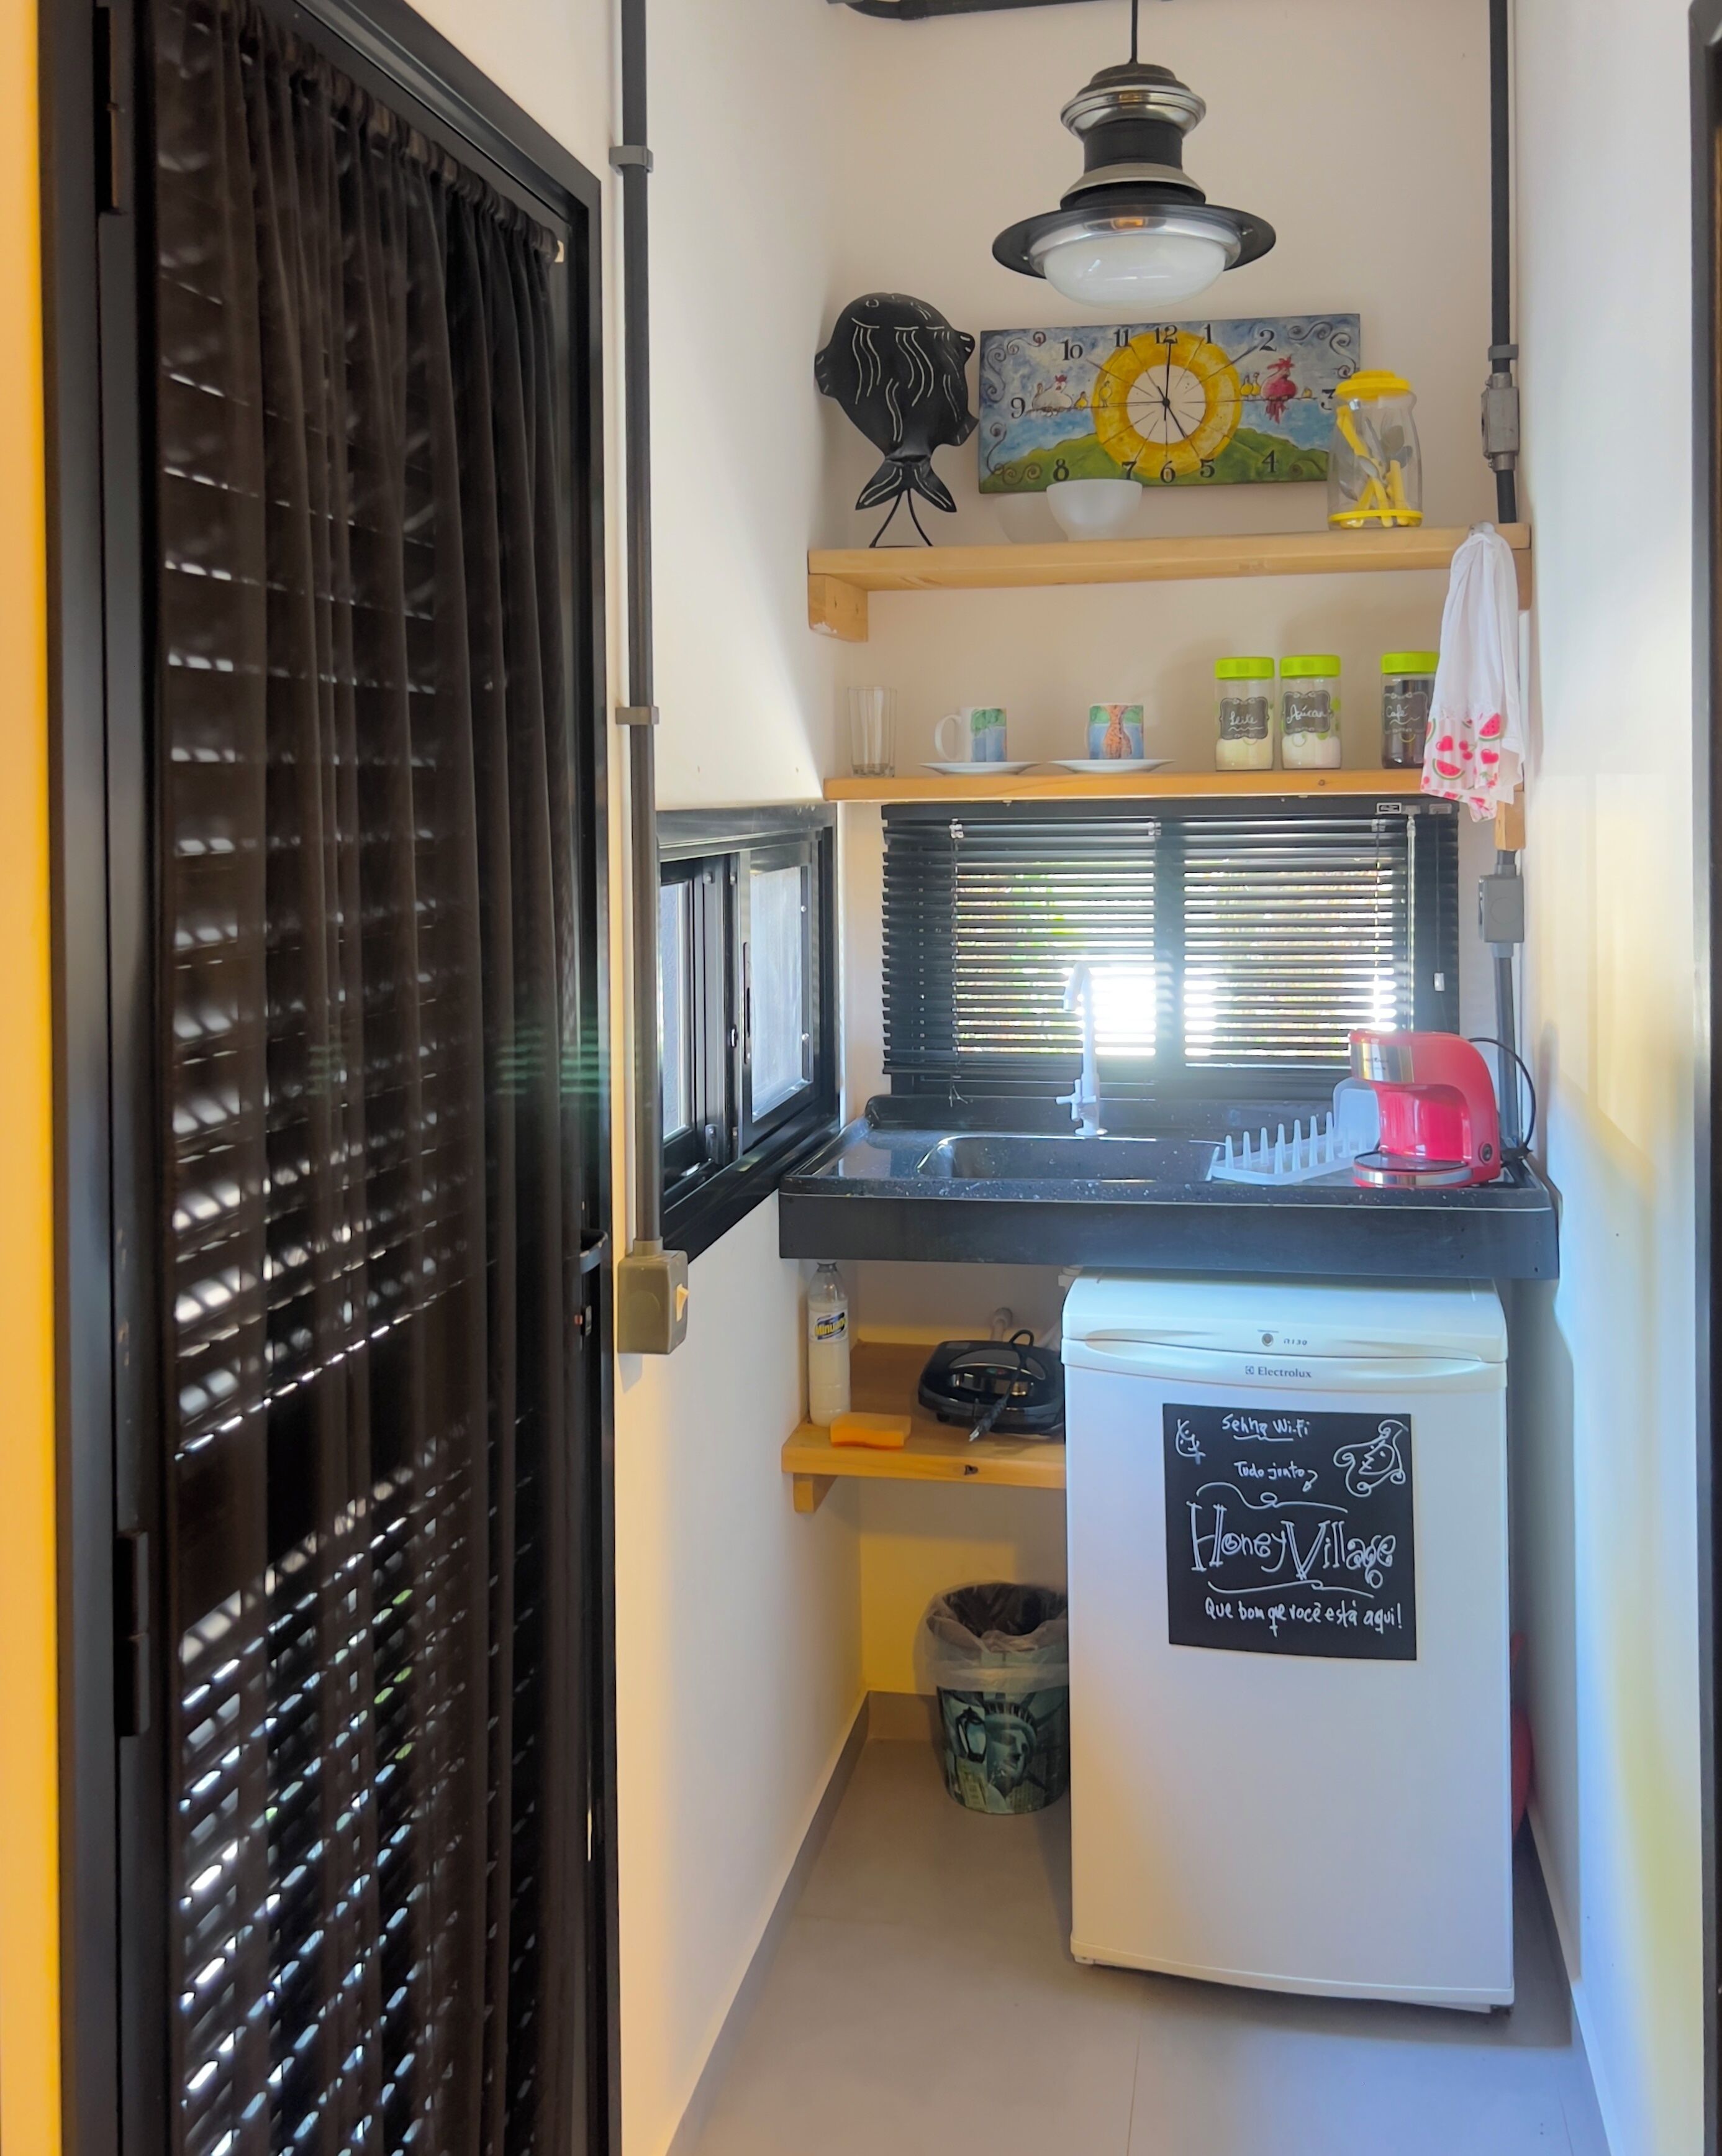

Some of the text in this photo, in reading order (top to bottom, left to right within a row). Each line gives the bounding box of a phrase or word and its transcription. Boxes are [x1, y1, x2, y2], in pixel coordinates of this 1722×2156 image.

[1113, 329, 1130, 348] 11
[1154, 325, 1179, 345] 12
[1202, 324, 1212, 344] 1
[1259, 329, 1277, 352] 2
[1061, 338, 1083, 361] 10
[1010, 397, 1026, 419] 9
[1053, 458, 1069, 482] 8
[1122, 461, 1137, 480] 7
[1160, 460, 1176, 483] 6
[1200, 458, 1217, 478] 5
[1261, 450, 1279, 474] 4
[1230, 711, 1258, 725] Leite
[1385, 704, 1408, 718] Café
[1258, 1366, 1312, 1378] Electrolux
[1221, 1413, 1268, 1437] Senha
[1233, 1460, 1305, 1480] Tudo junto
[1205, 1597, 1233, 1620] Que
[1238, 1601, 1265, 1621] bom
[1289, 1601, 1321, 1623] você
[1324, 1599, 1358, 1628] está
[1363, 1602, 1403, 1635] aqui!
